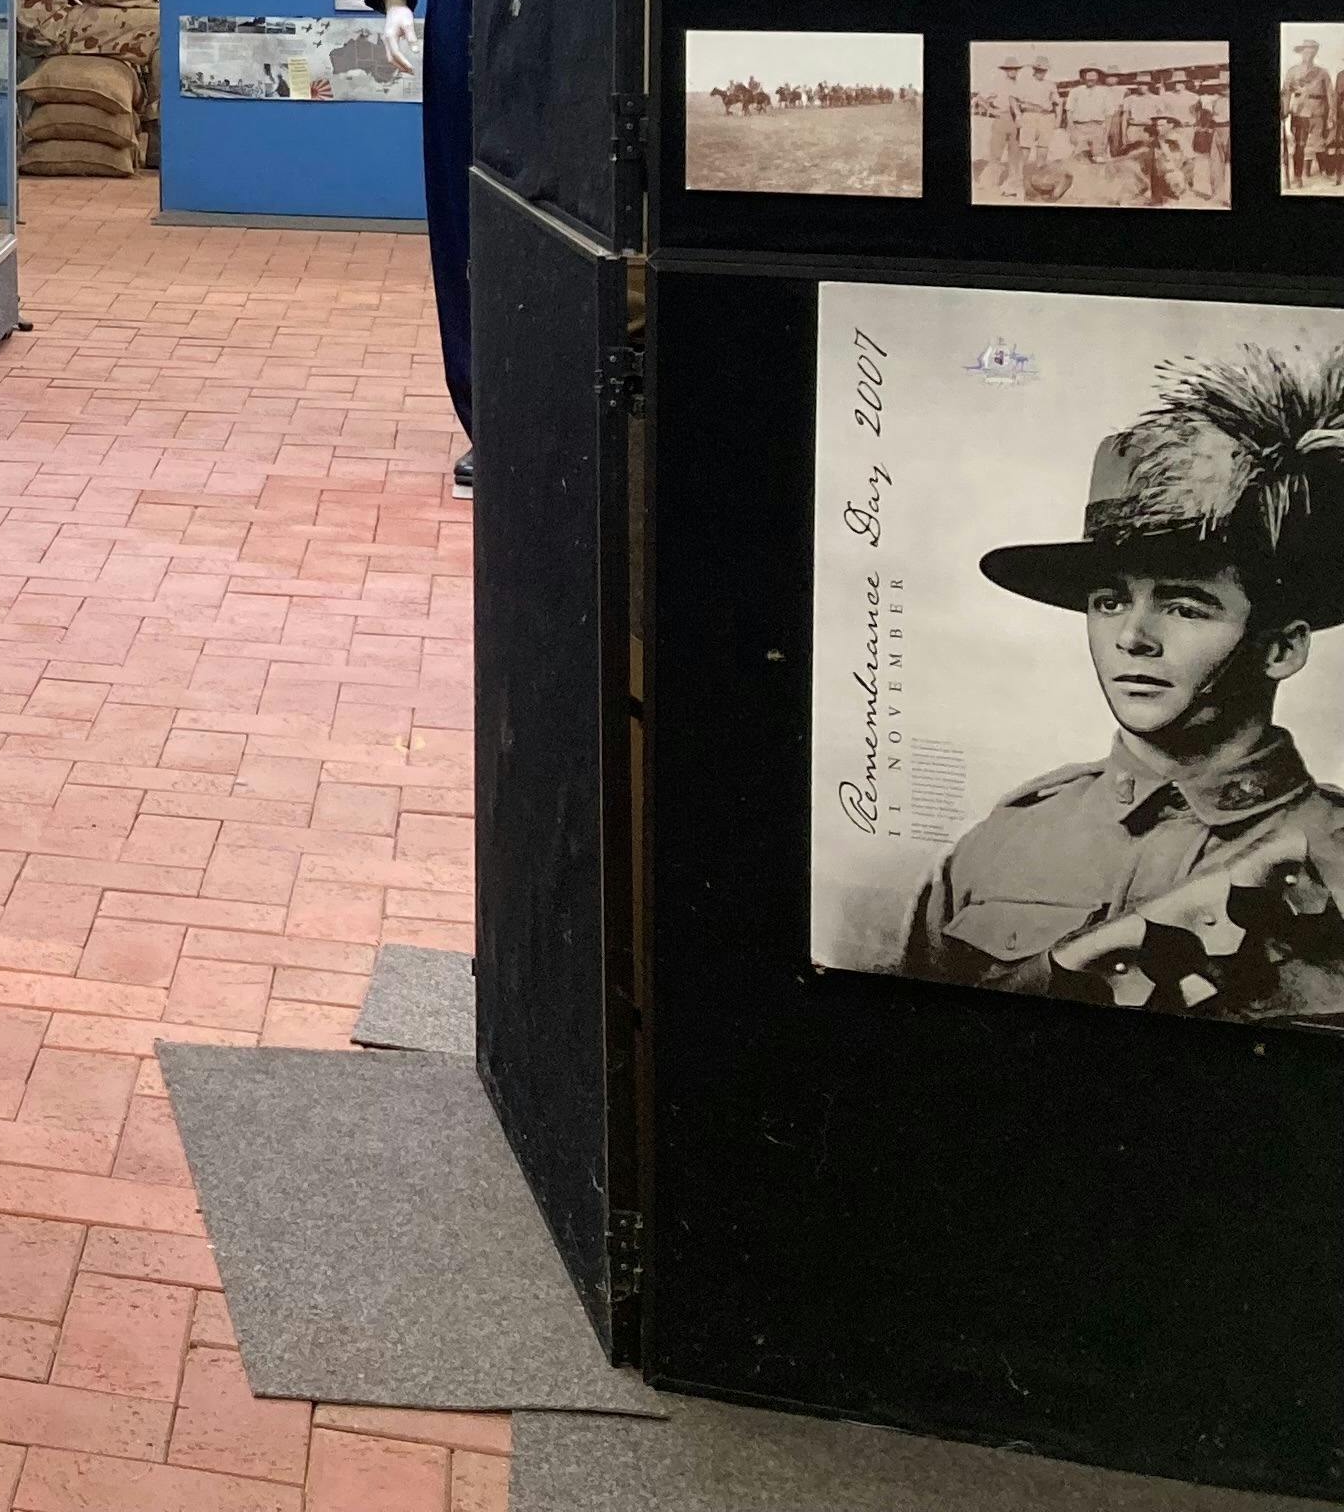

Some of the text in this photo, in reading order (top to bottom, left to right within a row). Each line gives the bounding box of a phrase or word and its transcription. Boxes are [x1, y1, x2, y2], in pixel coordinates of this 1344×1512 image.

[839, 326, 892, 835] Remembrance Day 2007
[888, 579, 904, 770] NOVEMBER
